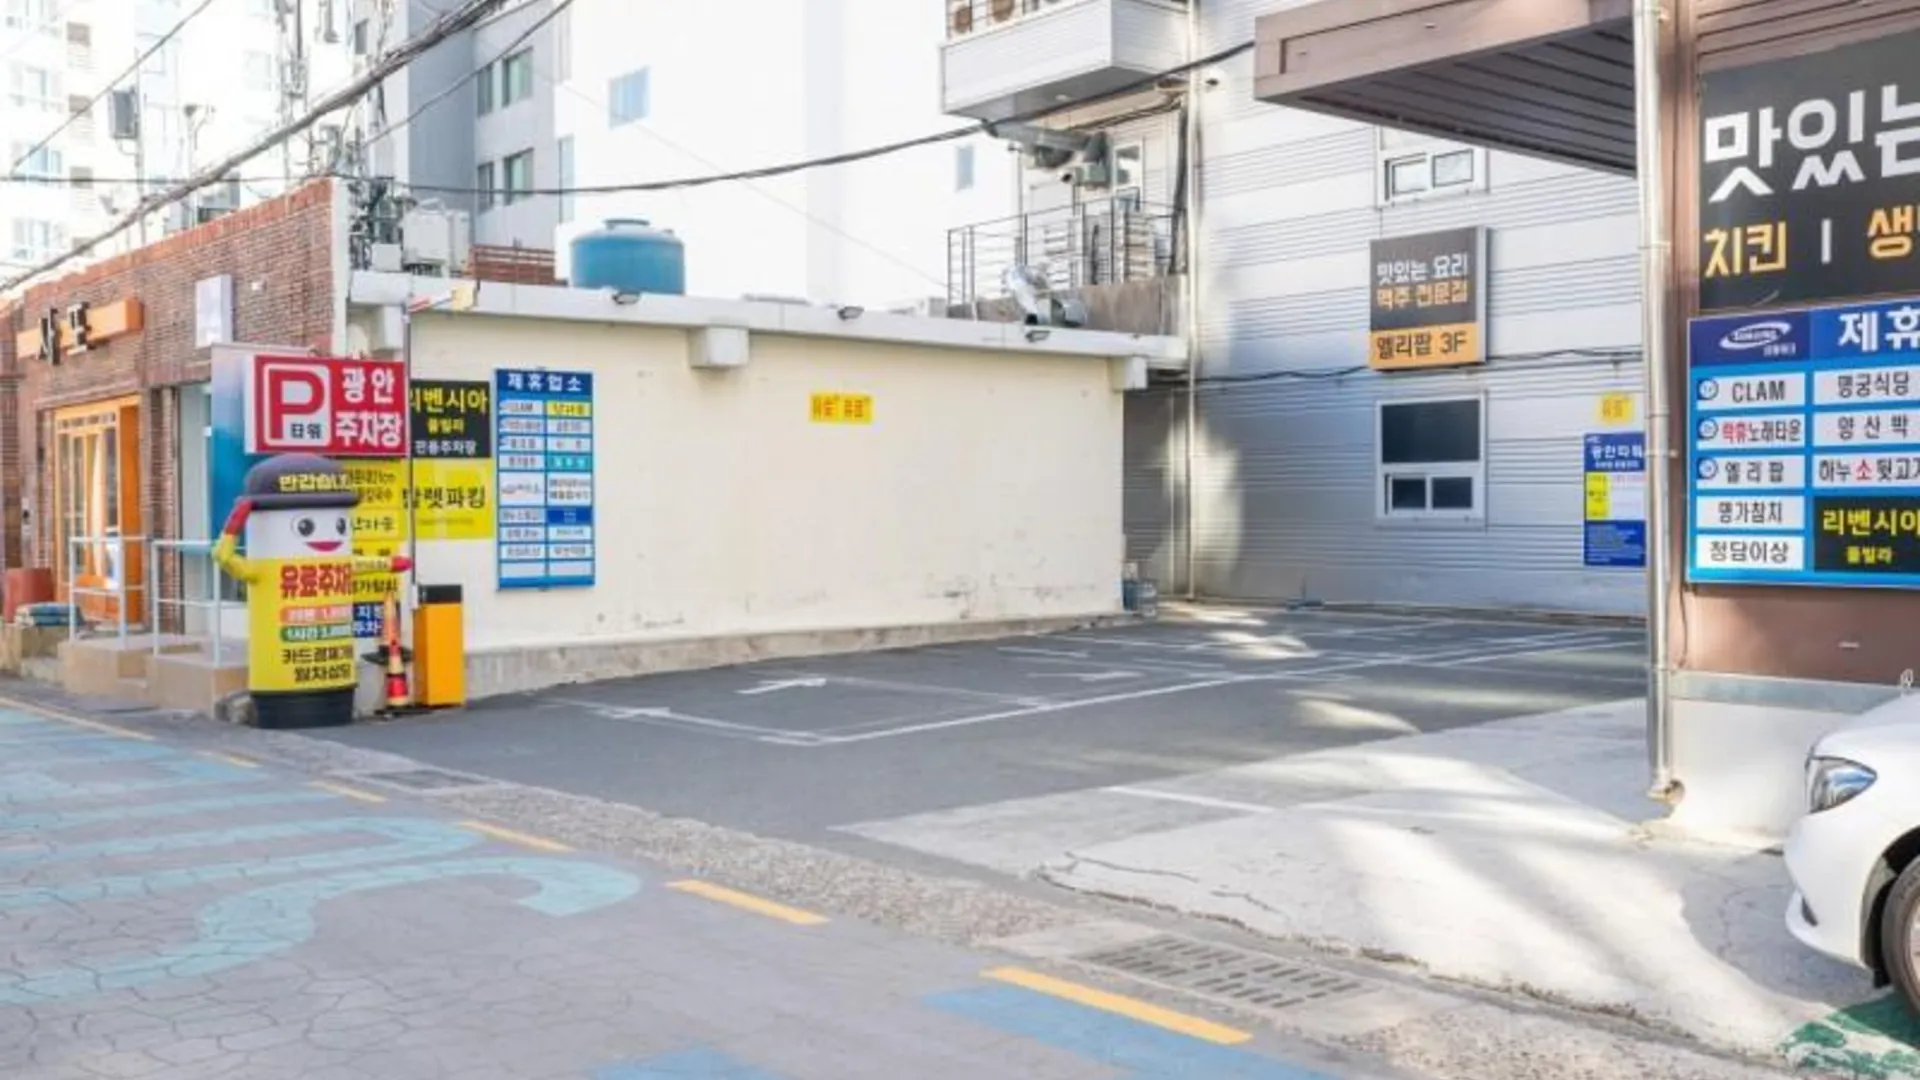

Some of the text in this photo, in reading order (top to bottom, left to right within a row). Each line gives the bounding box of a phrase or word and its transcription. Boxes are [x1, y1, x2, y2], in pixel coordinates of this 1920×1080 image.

[1705, 84, 1920, 204] 맛있는
[1704, 204, 1920, 278] 치킨 생
[1376, 252, 1468, 286] 맛있는 요리
[1376, 286, 1410, 311] 맥주
[1838, 306, 1920, 352] 제휴
[1376, 330, 1468, 360] 엘리팝 3F
[1731, 380, 1785, 404] CLAM
[1838, 371, 1909, 399] 명궁식당
[269, 369, 324, 439] P
[335, 410, 402, 449] 주차장
[1718, 501, 1783, 525] 명가참치
[1823, 508, 1920, 537] 리벤시아
[1710, 540, 1789, 563] 정담이상
